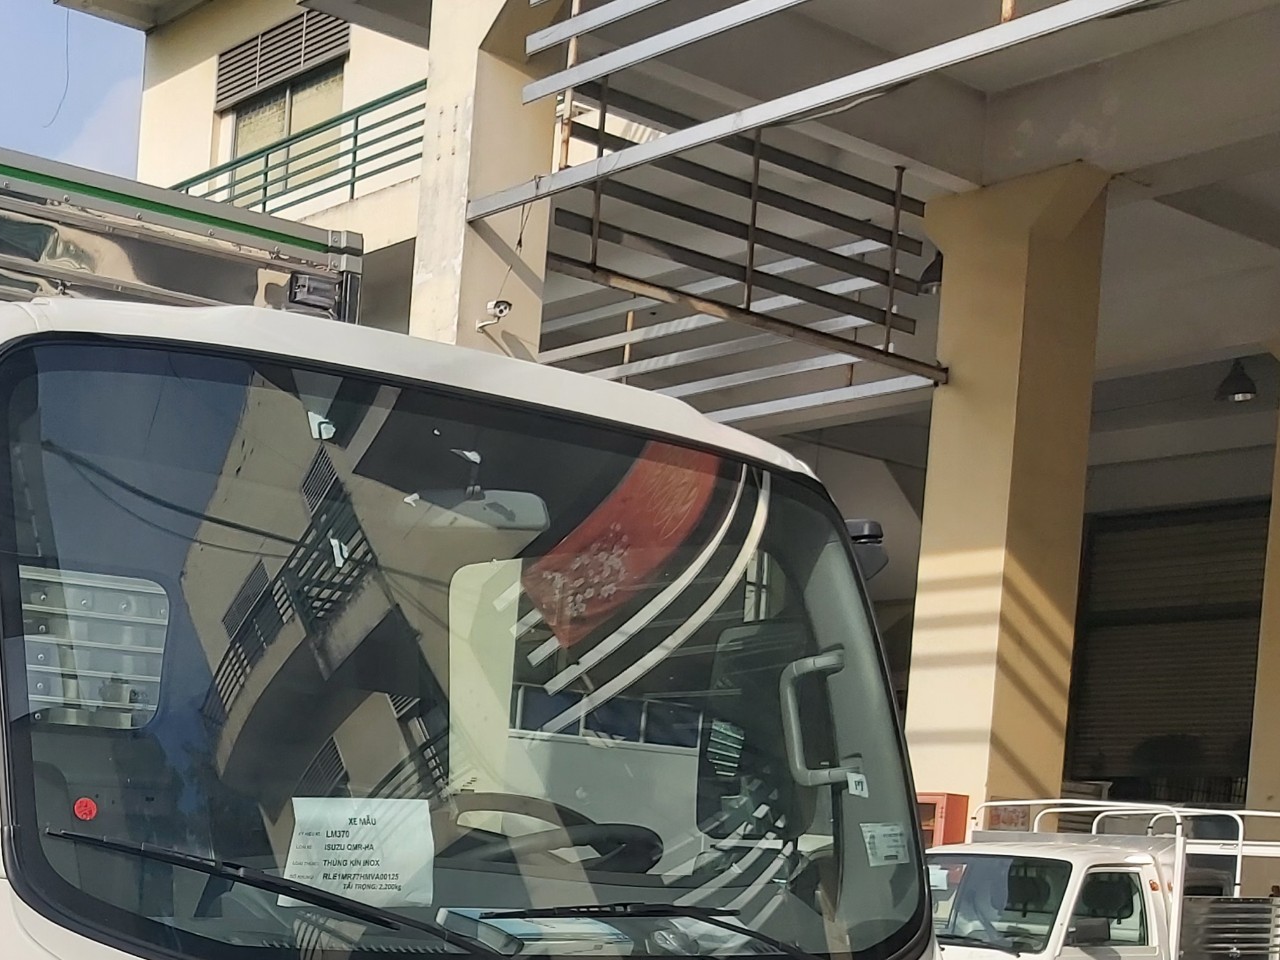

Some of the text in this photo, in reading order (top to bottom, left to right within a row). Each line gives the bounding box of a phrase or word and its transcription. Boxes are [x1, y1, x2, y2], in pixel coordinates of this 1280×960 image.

[348, 817, 357, 826] XE
[325, 830, 350, 838] LM370
[322, 857, 348, 867] THÙNG
[349, 857, 361, 867] KÍN
[362, 859, 380, 867] INOX
